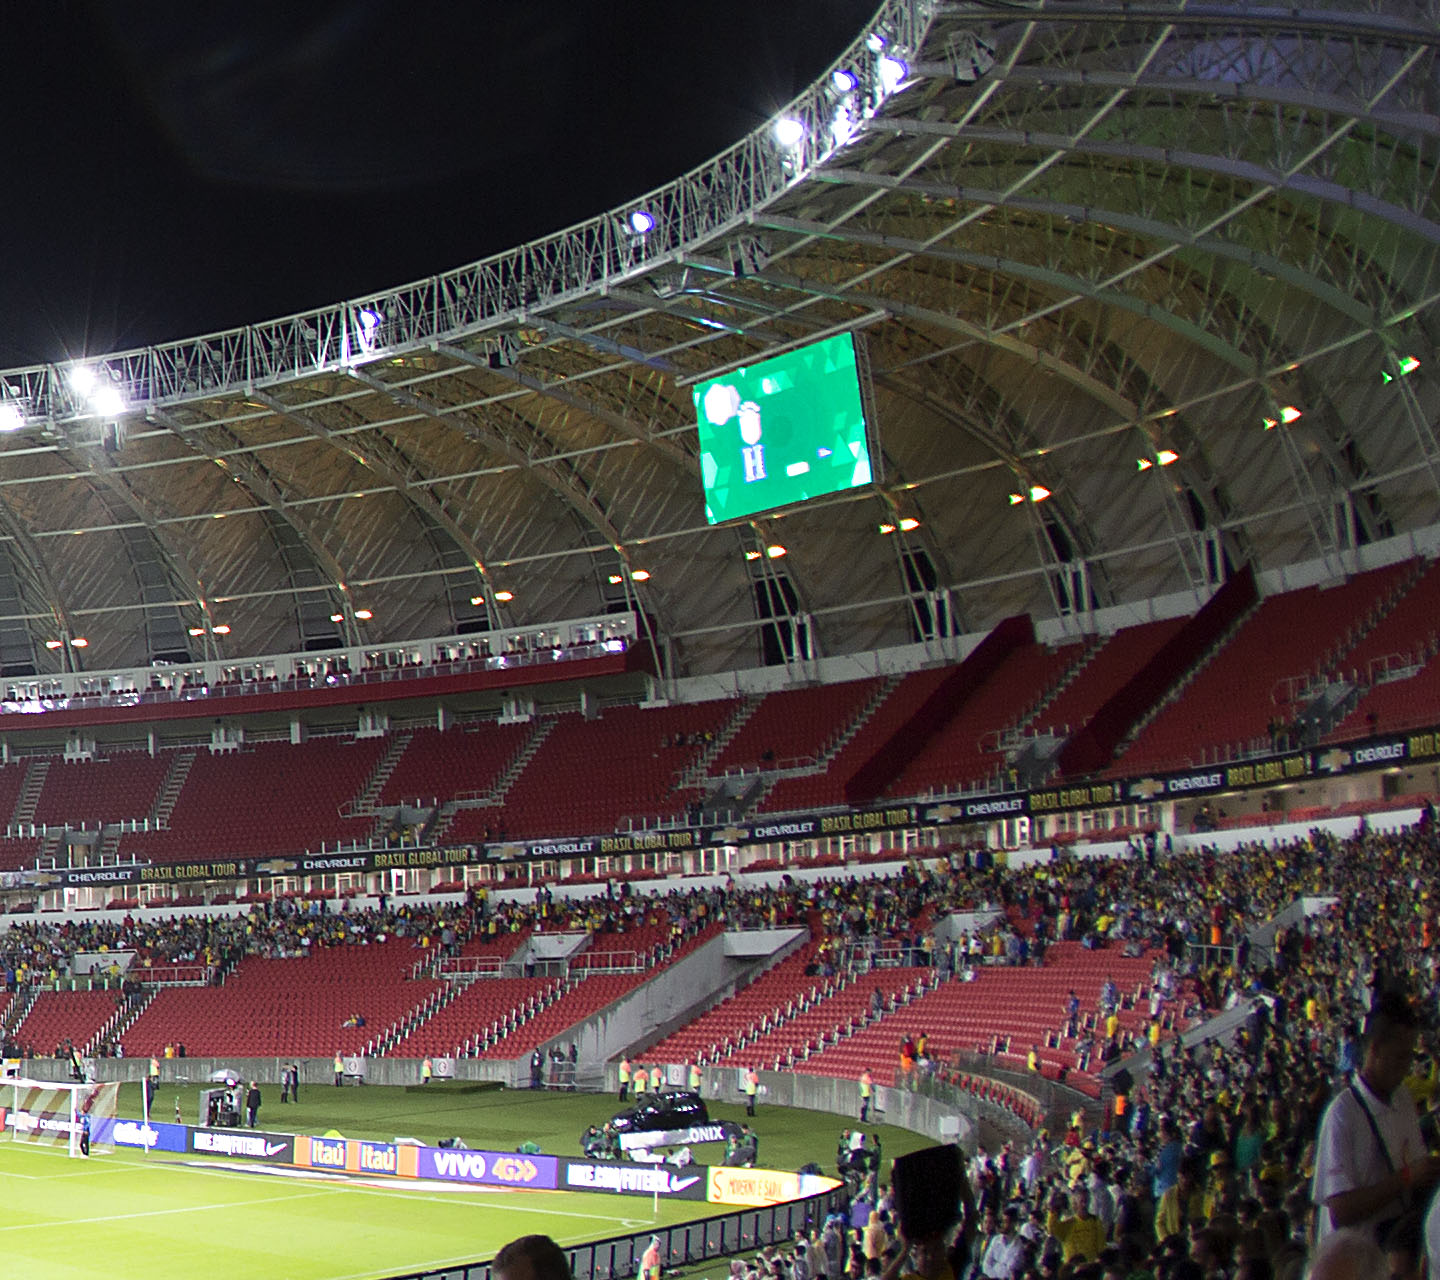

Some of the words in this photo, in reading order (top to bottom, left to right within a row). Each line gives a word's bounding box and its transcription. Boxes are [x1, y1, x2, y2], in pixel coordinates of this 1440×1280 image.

[1355, 743, 1404, 763] CHEVROLET
[1169, 774, 1222, 792] CHEVROLET
[967, 800, 1023, 816] CHEVROLET
[1030, 792, 1059, 811] BRASIL
[1060, 787, 1089, 806] GLOBAL
[1091, 784, 1113, 802] TOUR
[755, 822, 814, 838] CHEVROLET
[822, 816, 851, 833] BRASIL
[853, 811, 885, 828] GLOBAL
[886, 808, 908, 825] TOUR
[532, 842, 593, 855] CHEVROLET
[601, 838, 632, 852] BRASIL
[634, 835, 666, 849] GLOBAL
[668, 832, 692, 846] TOUR
[304, 858, 367, 869] CHEVROLET
[375, 853, 406, 866] BRASIL
[408, 851, 441, 863] GLOBAL
[444, 848, 468, 861] TOUR
[68, 871, 132, 882] CHEVROLET
[141, 868, 173, 880] BRASIL
[176, 866, 209, 877] GLOBAL
[212, 864, 236, 875] TOUR
[690, 1126, 725, 1143] ONIX
[312, 1140, 344, 1166] Itaú
[361, 1144, 396, 1170] Itaú
[434, 1152, 486, 1178] VIVO
